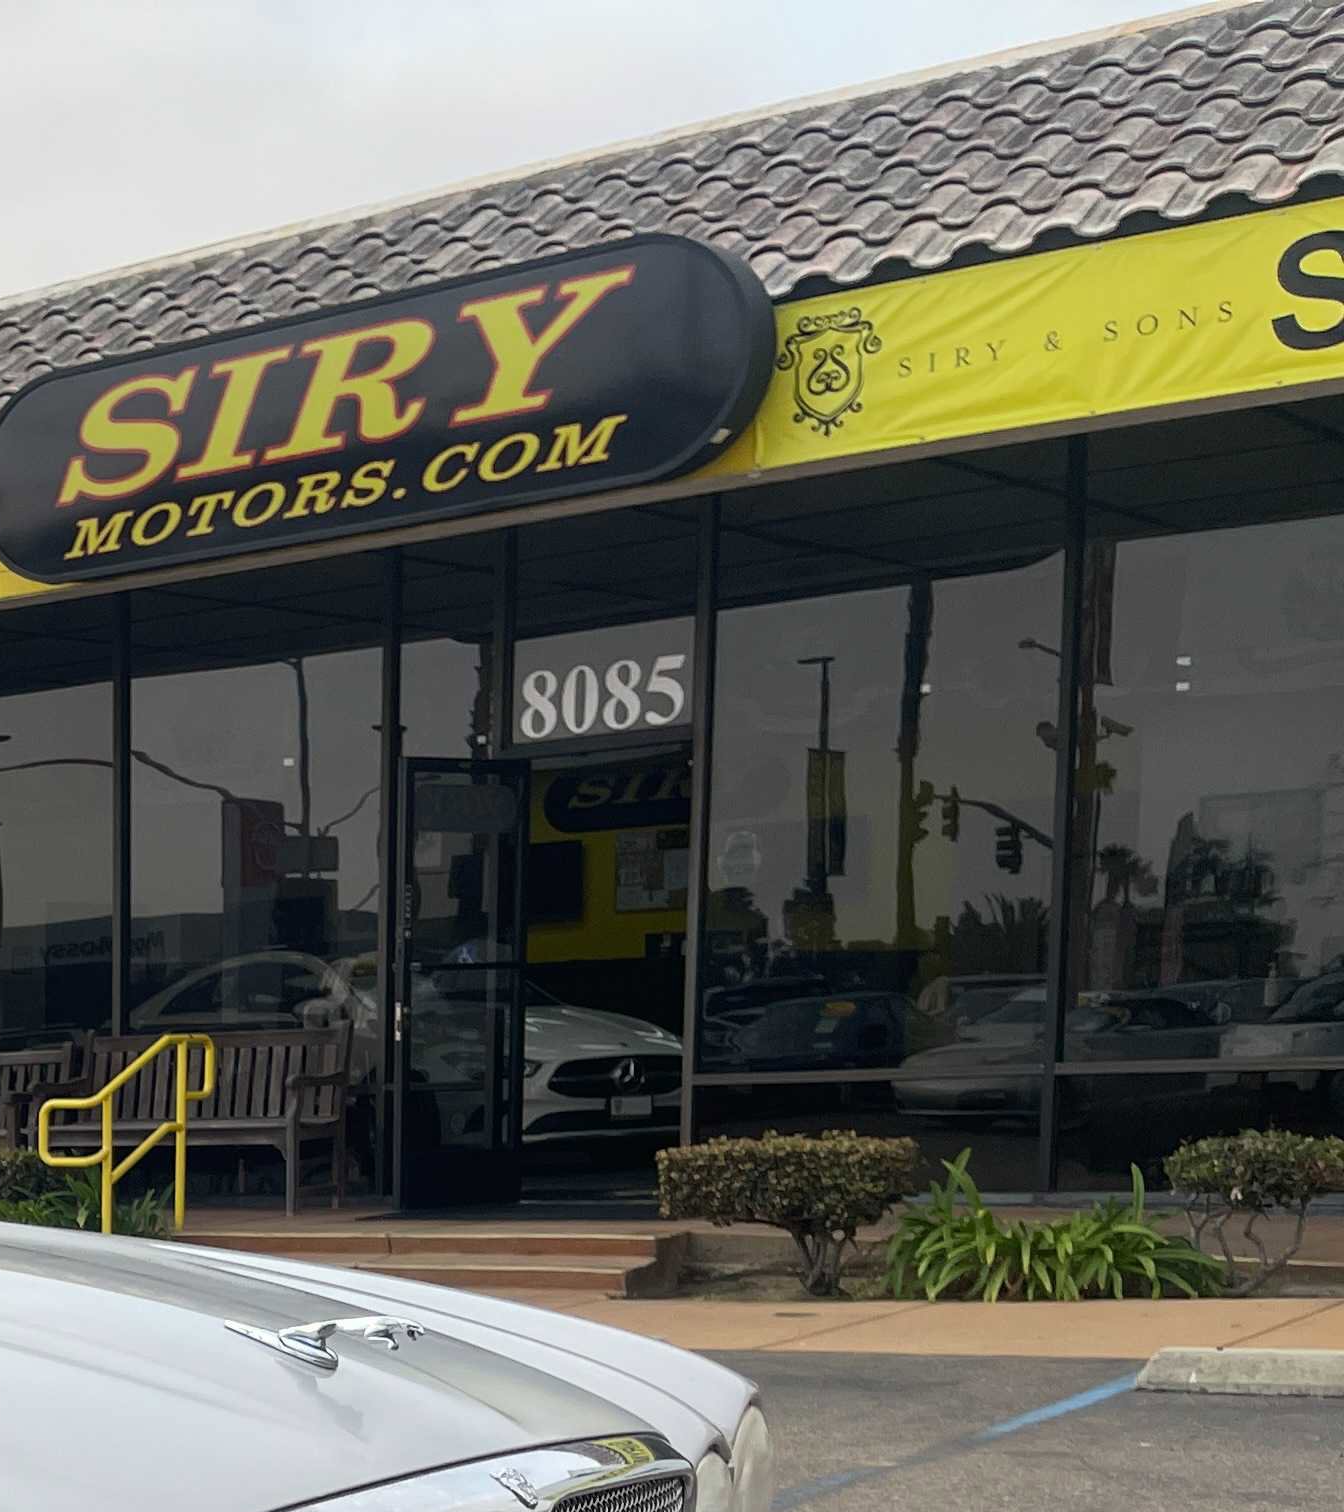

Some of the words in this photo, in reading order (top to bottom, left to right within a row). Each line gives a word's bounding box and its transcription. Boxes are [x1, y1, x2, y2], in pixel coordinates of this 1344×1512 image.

[56, 264, 636, 507] SIRY
[897, 339, 1007, 378] SIRY
[1043, 331, 1063, 353] &
[1103, 301, 1234, 343] SONS
[64, 414, 628, 560] MOTORS.COM
[520, 654, 686, 738] 8085
